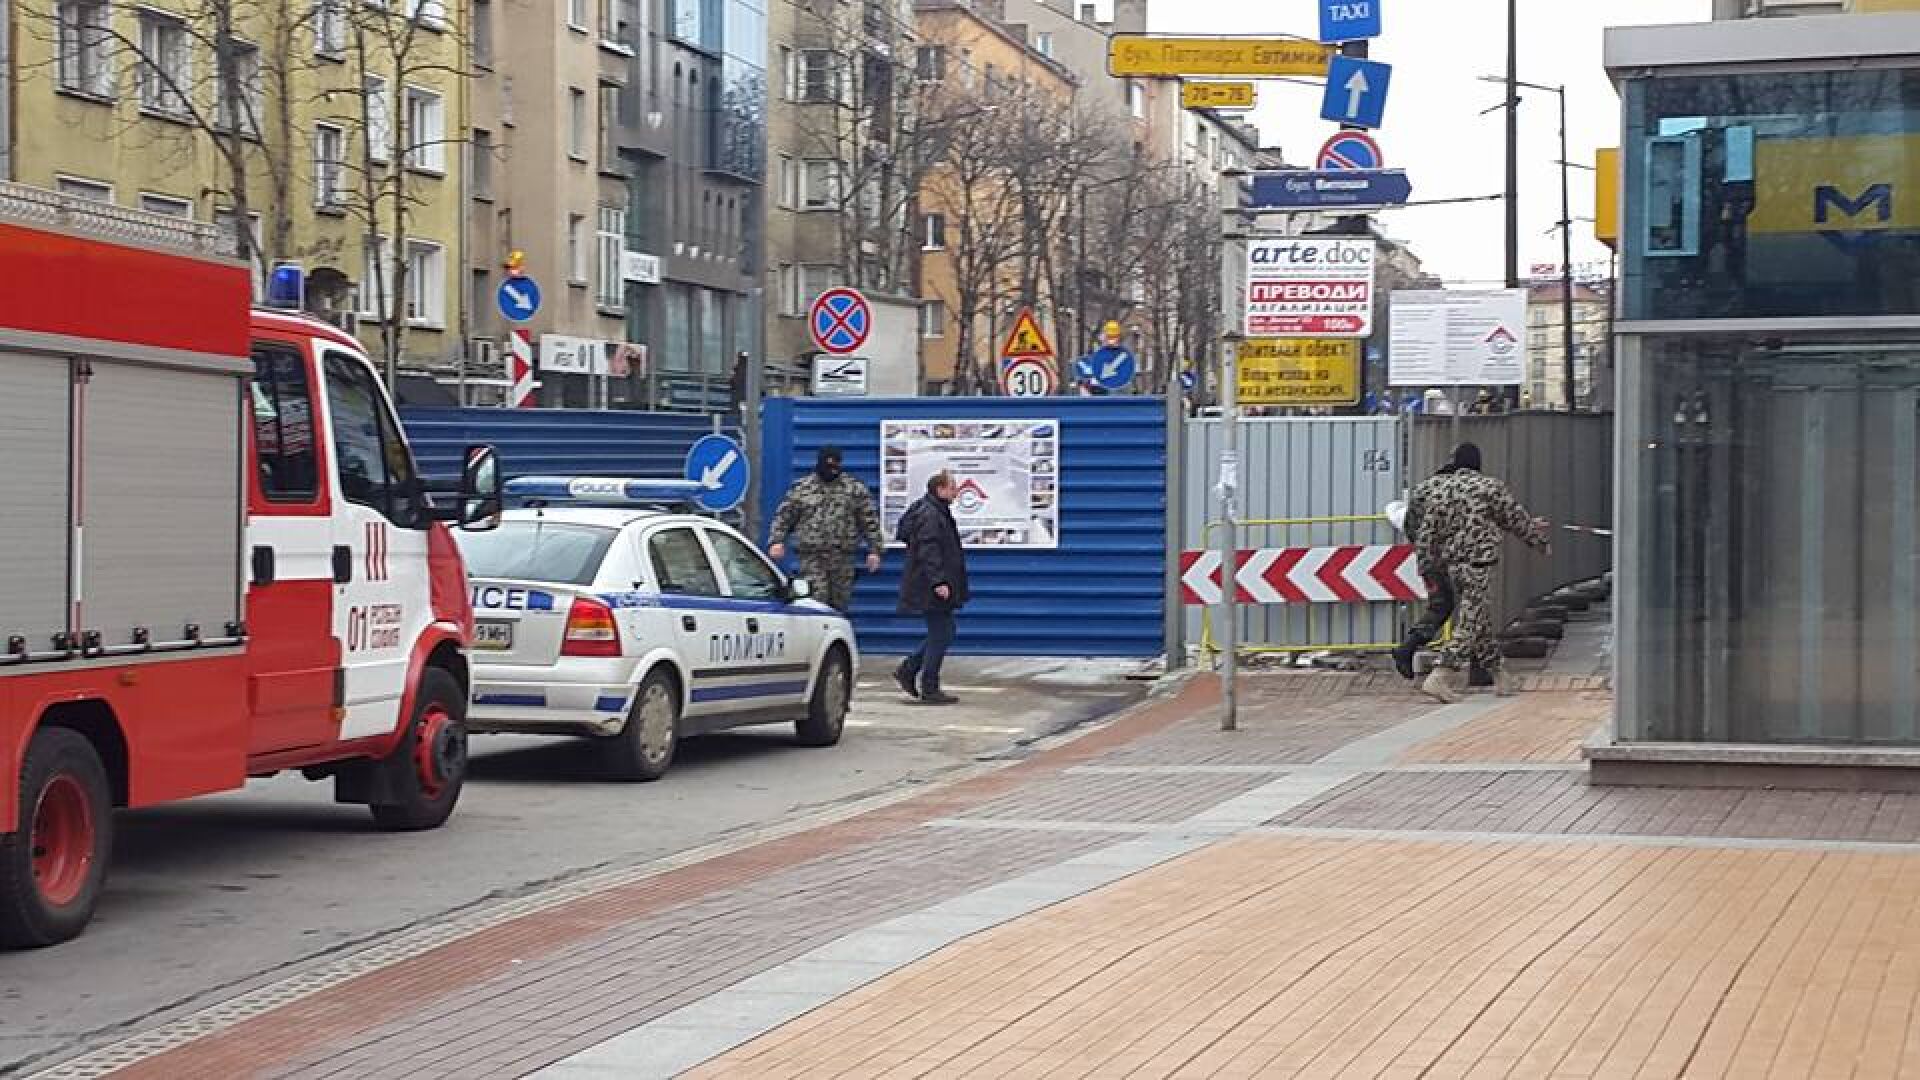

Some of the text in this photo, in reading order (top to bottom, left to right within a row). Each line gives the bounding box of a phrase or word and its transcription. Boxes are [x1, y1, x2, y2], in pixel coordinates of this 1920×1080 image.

[1328, 2, 1369, 22] TAXI
[1162, 44, 1243, 65] Патриарх
[1251, 242, 1371, 264] arte.doc
[1252, 284, 1365, 299] ПРЕВОДИ
[1249, 303, 1369, 313] ЛЕГАЛИЗАЦИЯ
[1013, 370, 1043, 396] 30
[573, 482, 619, 493] POLICE
[348, 605, 369, 653] 01
[709, 631, 785, 663] ПОЛИЦИЯ
